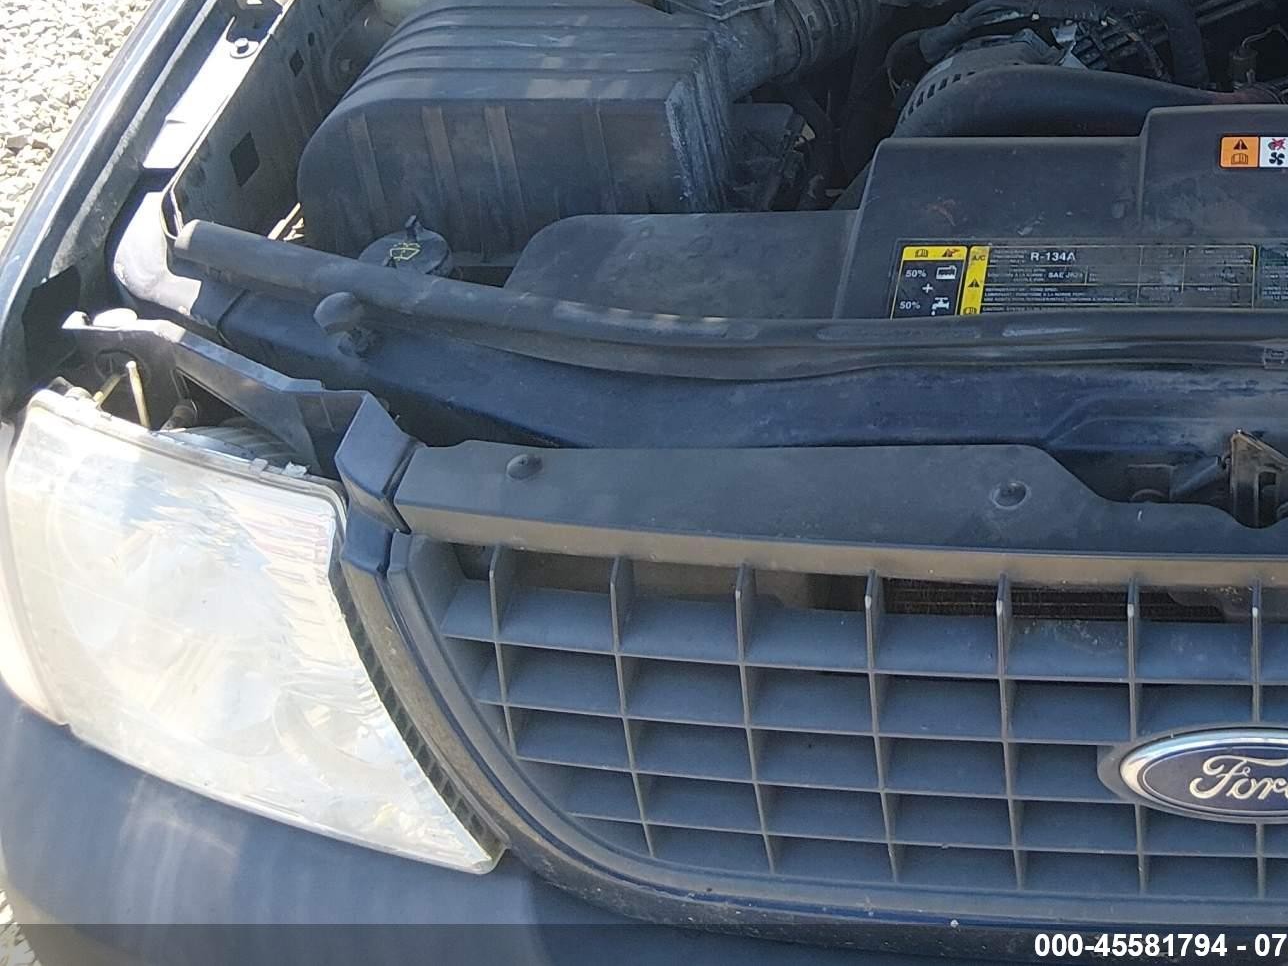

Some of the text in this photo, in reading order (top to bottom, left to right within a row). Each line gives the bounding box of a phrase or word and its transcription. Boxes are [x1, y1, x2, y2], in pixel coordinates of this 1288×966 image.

[1030, 251, 1076, 262] R-134A
[905, 269, 927, 278] 50%
[899, 300, 921, 310] 50%
